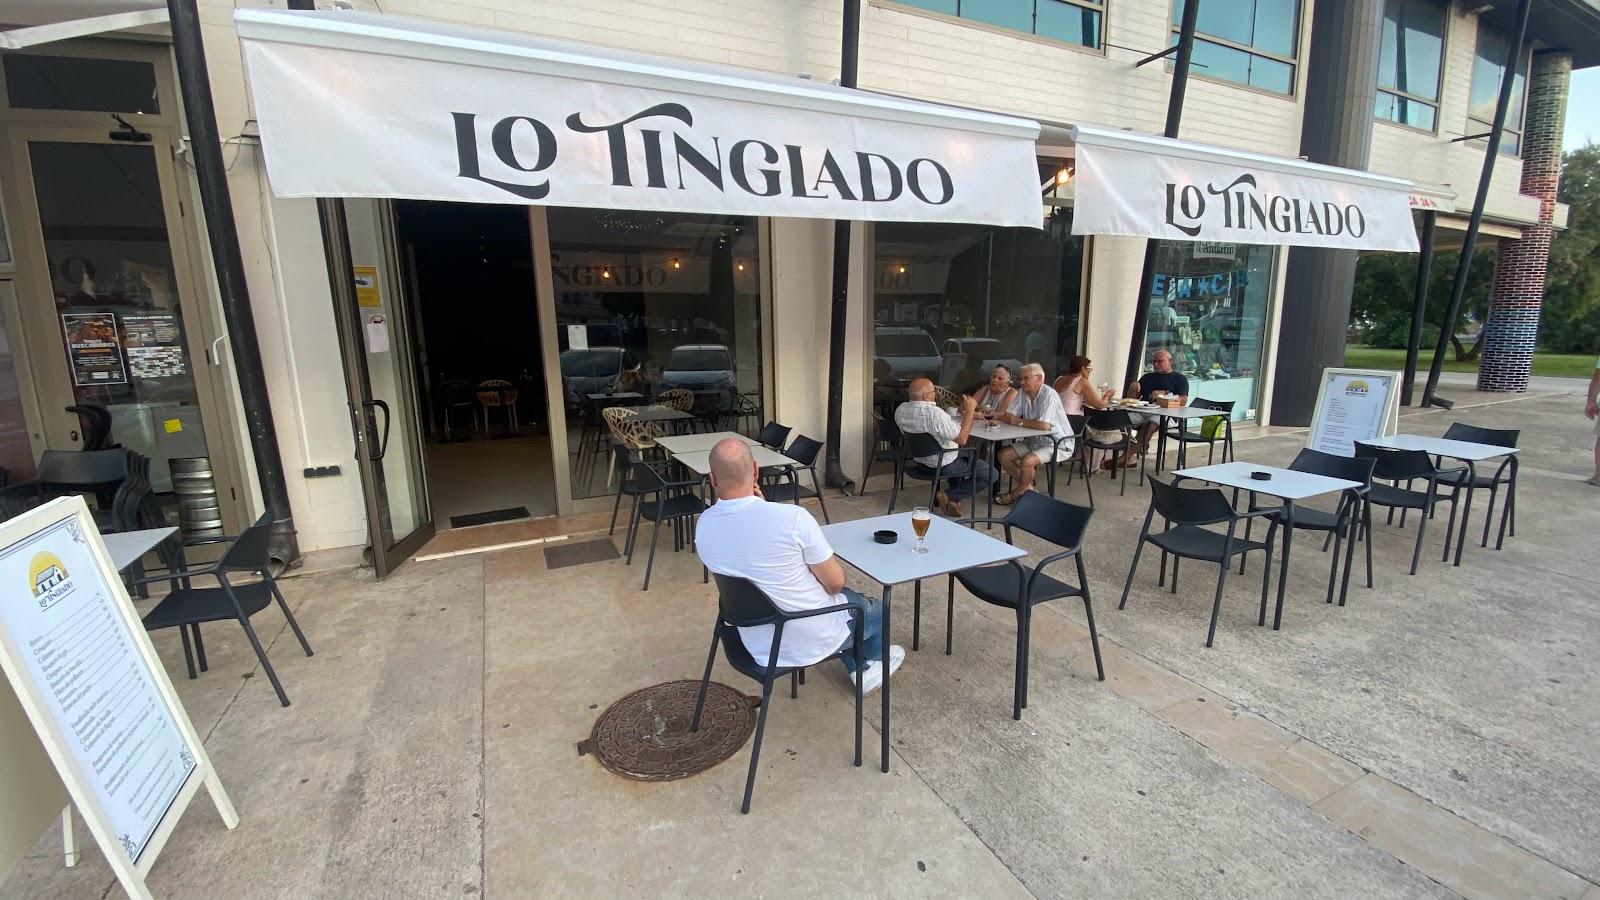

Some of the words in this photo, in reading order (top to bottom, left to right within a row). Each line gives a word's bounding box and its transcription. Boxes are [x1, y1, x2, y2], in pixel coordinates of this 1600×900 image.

[450, 111, 558, 200] LO
[565, 102, 955, 206] TINGLADO
[1165, 183, 1206, 237] LO
[1207, 173, 1366, 239] TINGLADO
